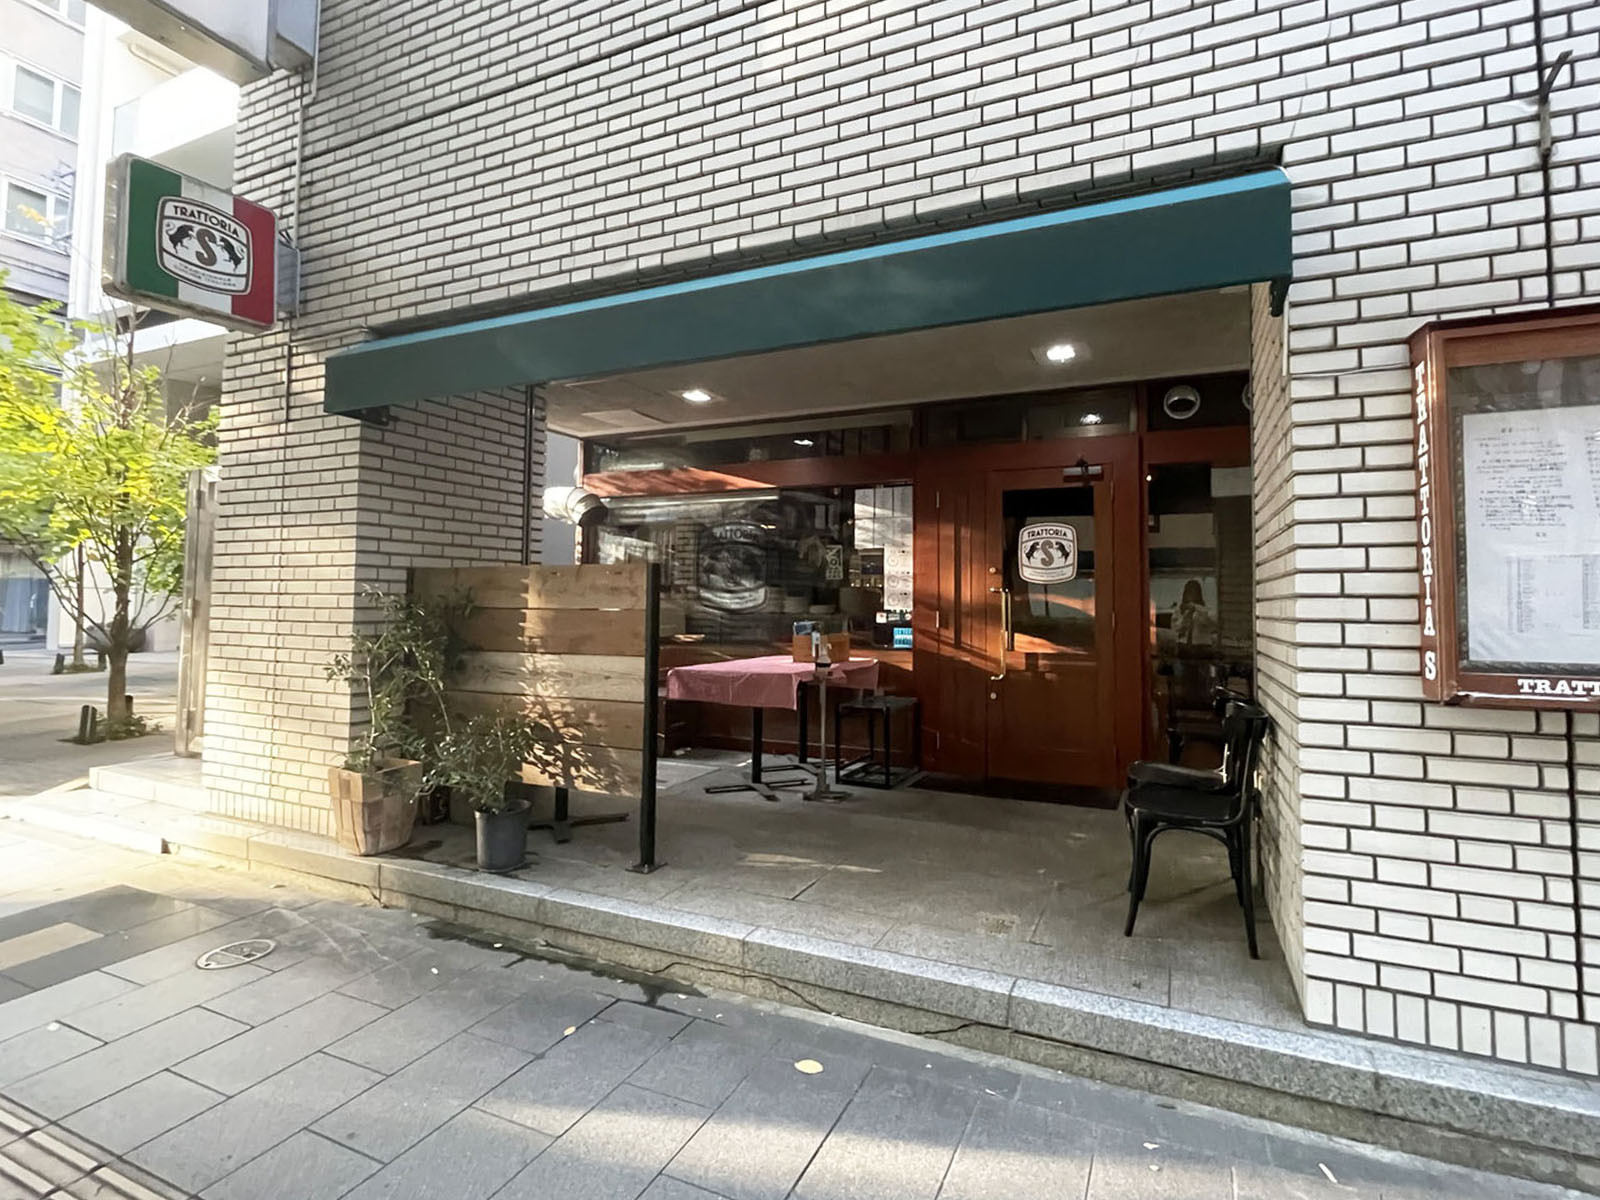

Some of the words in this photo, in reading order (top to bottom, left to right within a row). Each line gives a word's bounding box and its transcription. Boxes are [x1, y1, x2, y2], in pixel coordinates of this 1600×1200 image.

[173, 205, 239, 238] TRATTORIA
[195, 228, 217, 267] S
[1414, 361, 1435, 636] TRATTORIA
[1027, 528, 1068, 538] TRATTORIA
[1040, 539, 1055, 567] S
[1424, 651, 1437, 681] S
[1517, 678, 1600, 696] TRATT
